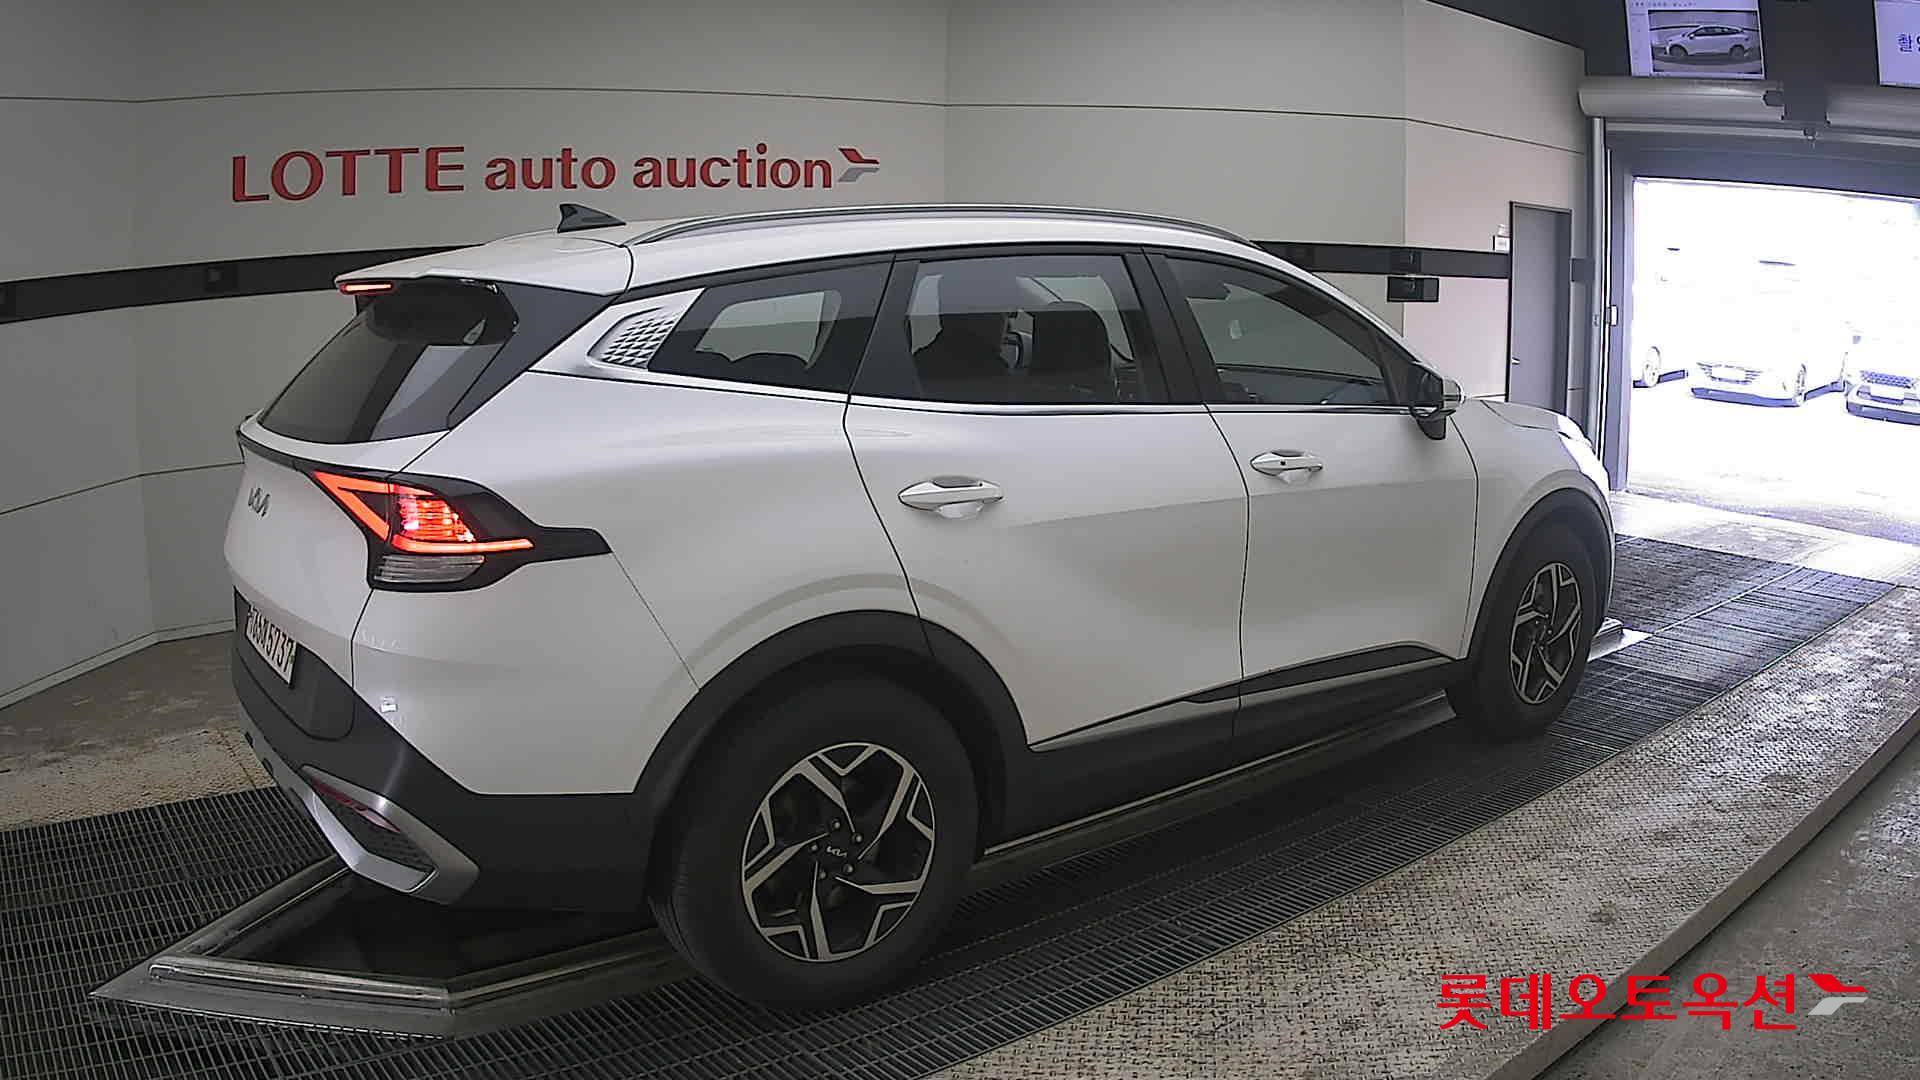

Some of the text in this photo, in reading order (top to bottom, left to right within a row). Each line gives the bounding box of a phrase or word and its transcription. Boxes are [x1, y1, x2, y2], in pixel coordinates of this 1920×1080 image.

[233, 143, 833, 201] LOTTE auto auction
